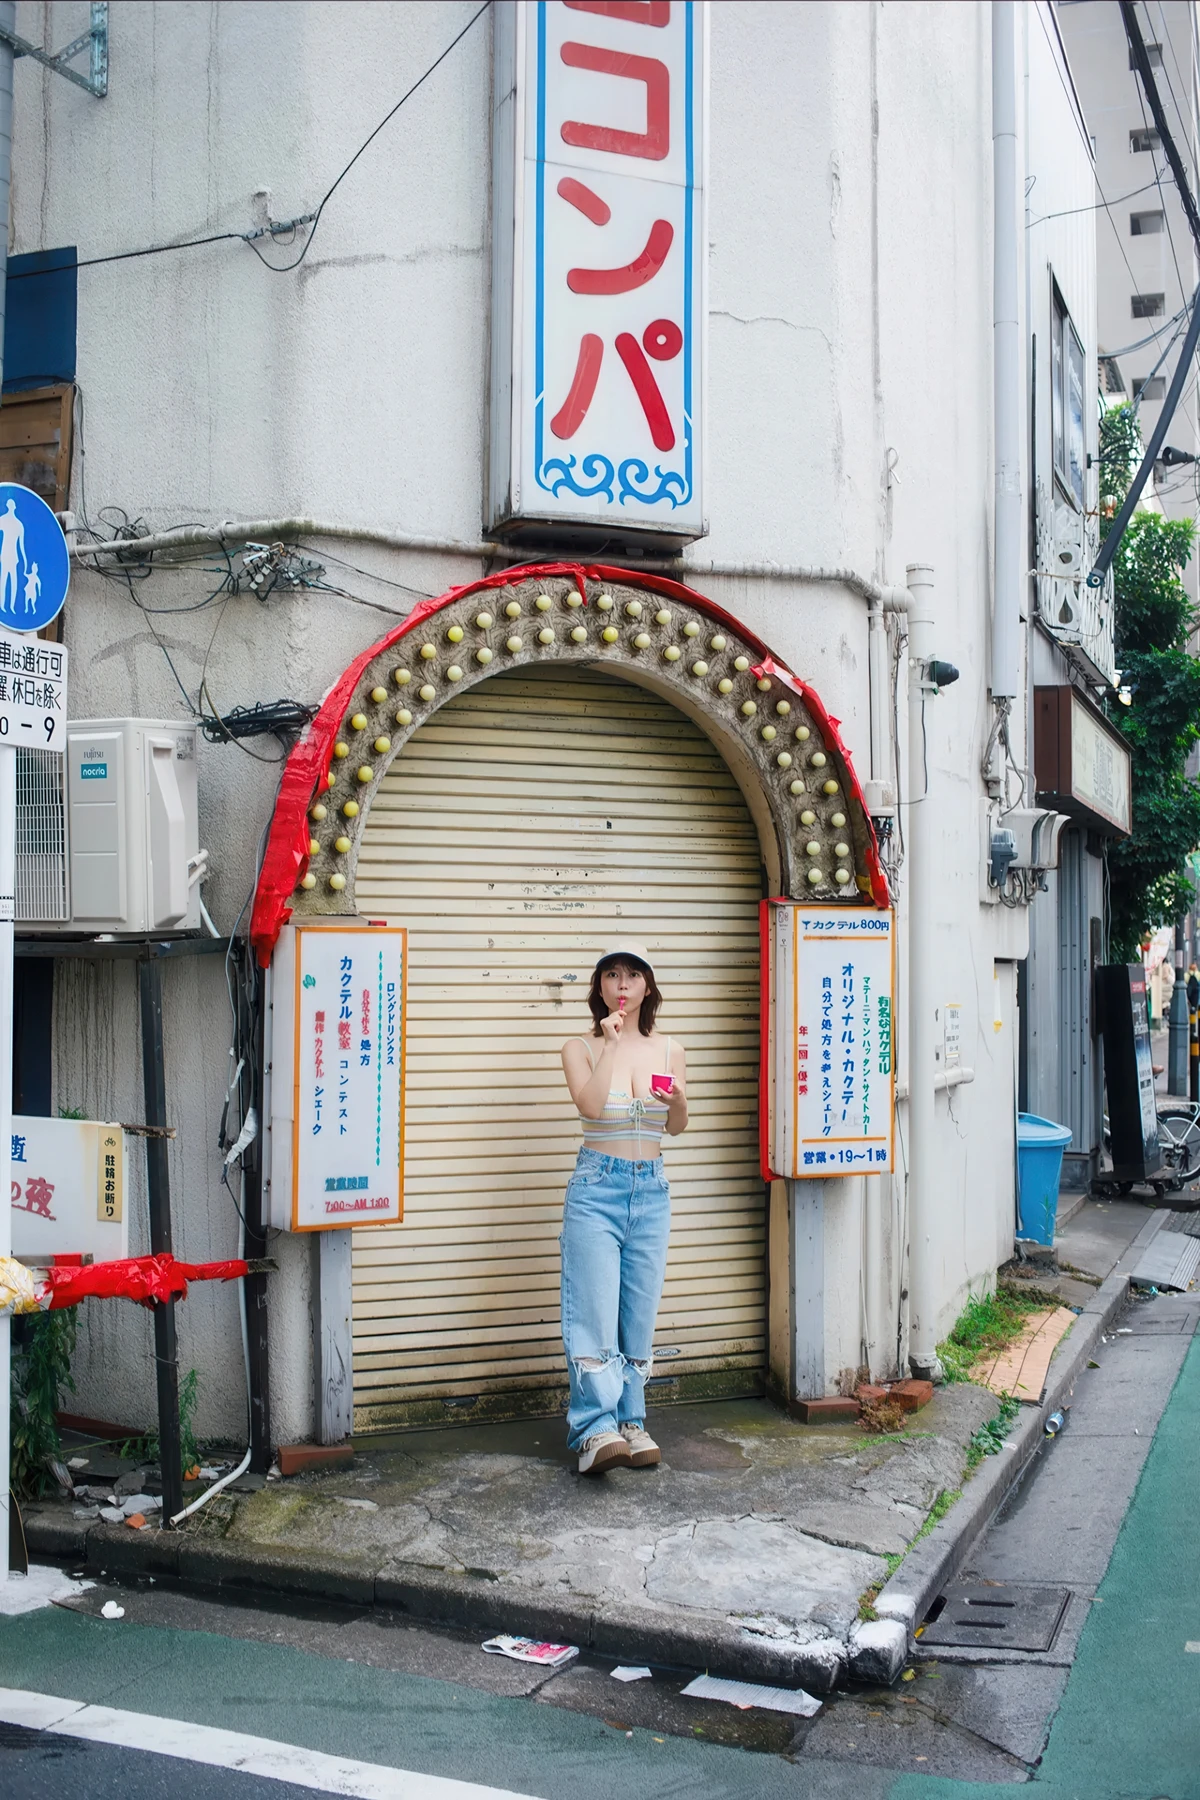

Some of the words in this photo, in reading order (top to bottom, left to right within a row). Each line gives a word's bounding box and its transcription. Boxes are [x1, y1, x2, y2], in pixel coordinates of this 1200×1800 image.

[82, 767, 106, 777] nocria
[83, 747, 104, 760] FUJITSU
[812, 919, 890, 931] カクテル800円
[386, 982, 397, 1065] ロングドリンクス
[878, 996, 891, 1075] 有名なカクテル
[105, 1154, 115, 1217] 駐輪お断り
